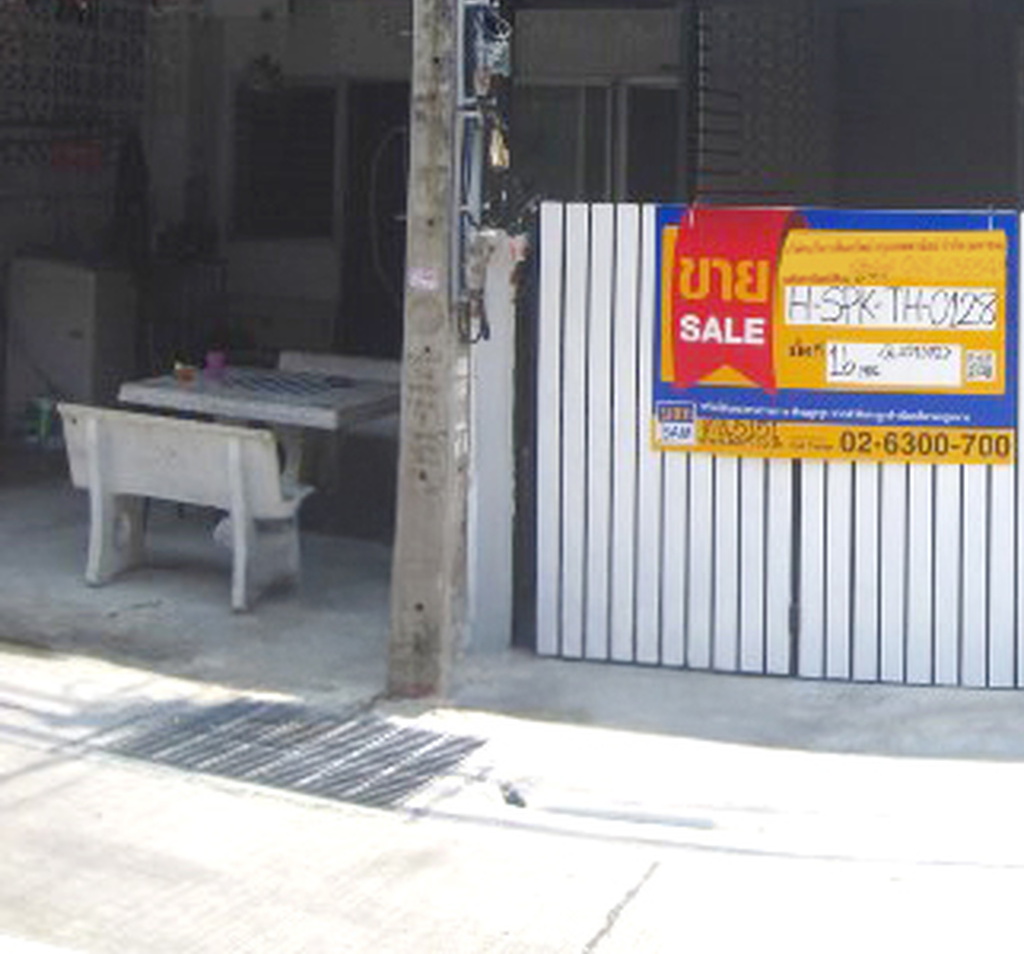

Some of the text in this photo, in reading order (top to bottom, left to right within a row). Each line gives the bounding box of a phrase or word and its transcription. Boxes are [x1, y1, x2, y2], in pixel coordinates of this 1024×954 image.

[680, 257, 770, 301] ขาย
[680, 313, 764, 344] SALE
[841, 430, 1010, 457] 02-6300-700
